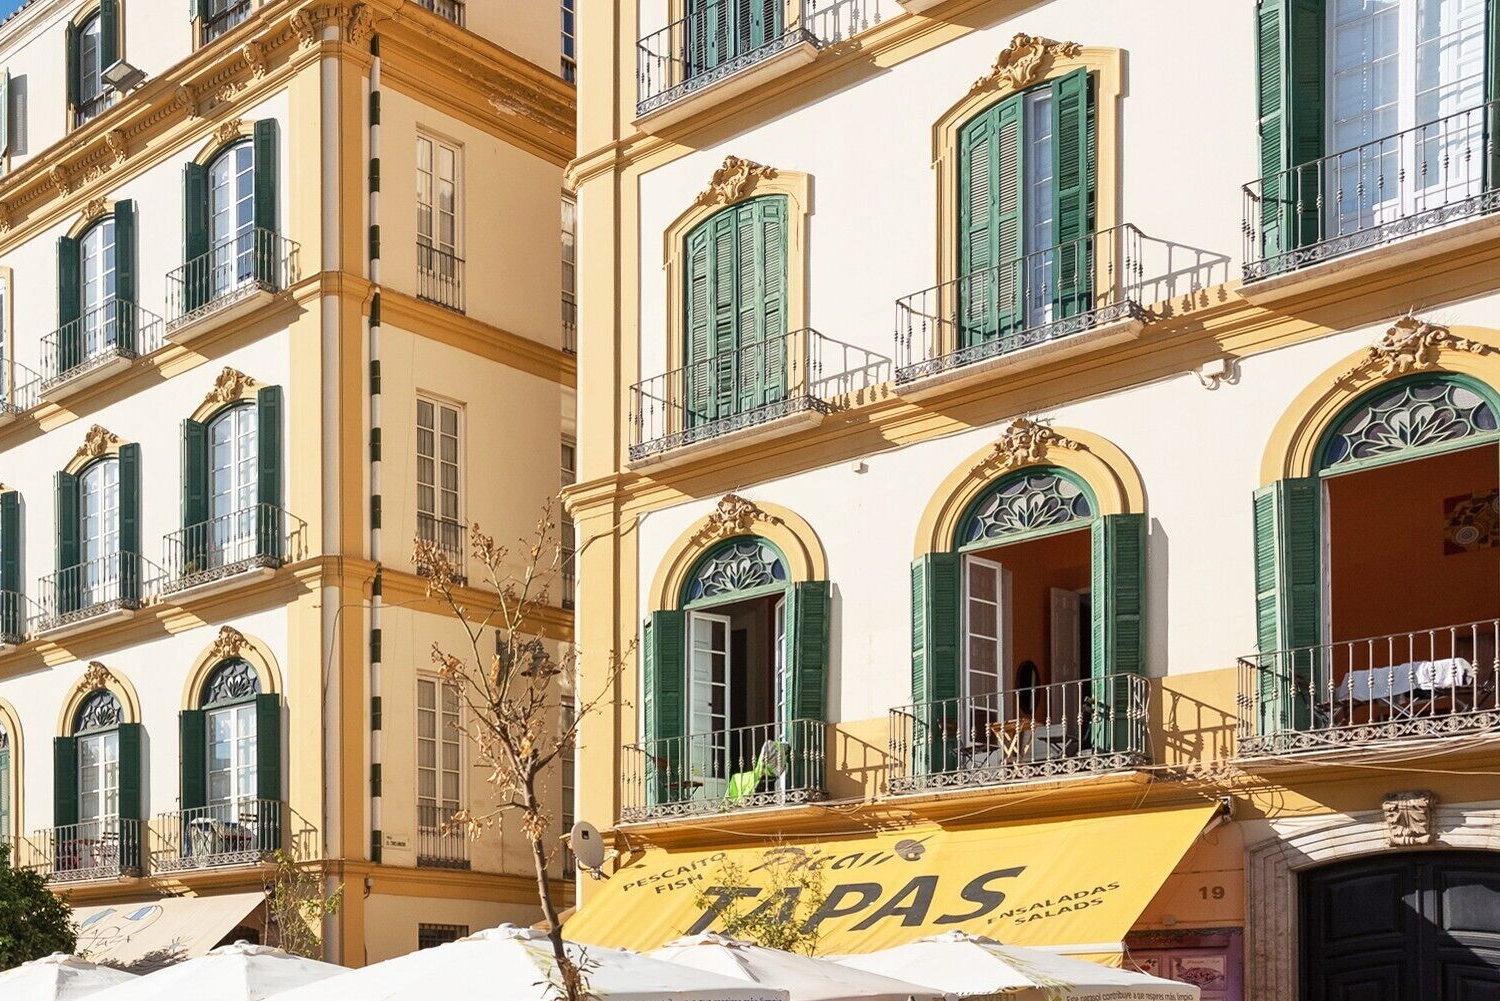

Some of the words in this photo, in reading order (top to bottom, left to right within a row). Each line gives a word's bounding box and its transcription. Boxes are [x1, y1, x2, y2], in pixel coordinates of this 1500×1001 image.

[655, 873, 704, 894] FISH
[1199, 886, 1225, 899] 19
[684, 866, 1028, 936] TAPAS
[1014, 897, 1104, 926] SALADS
